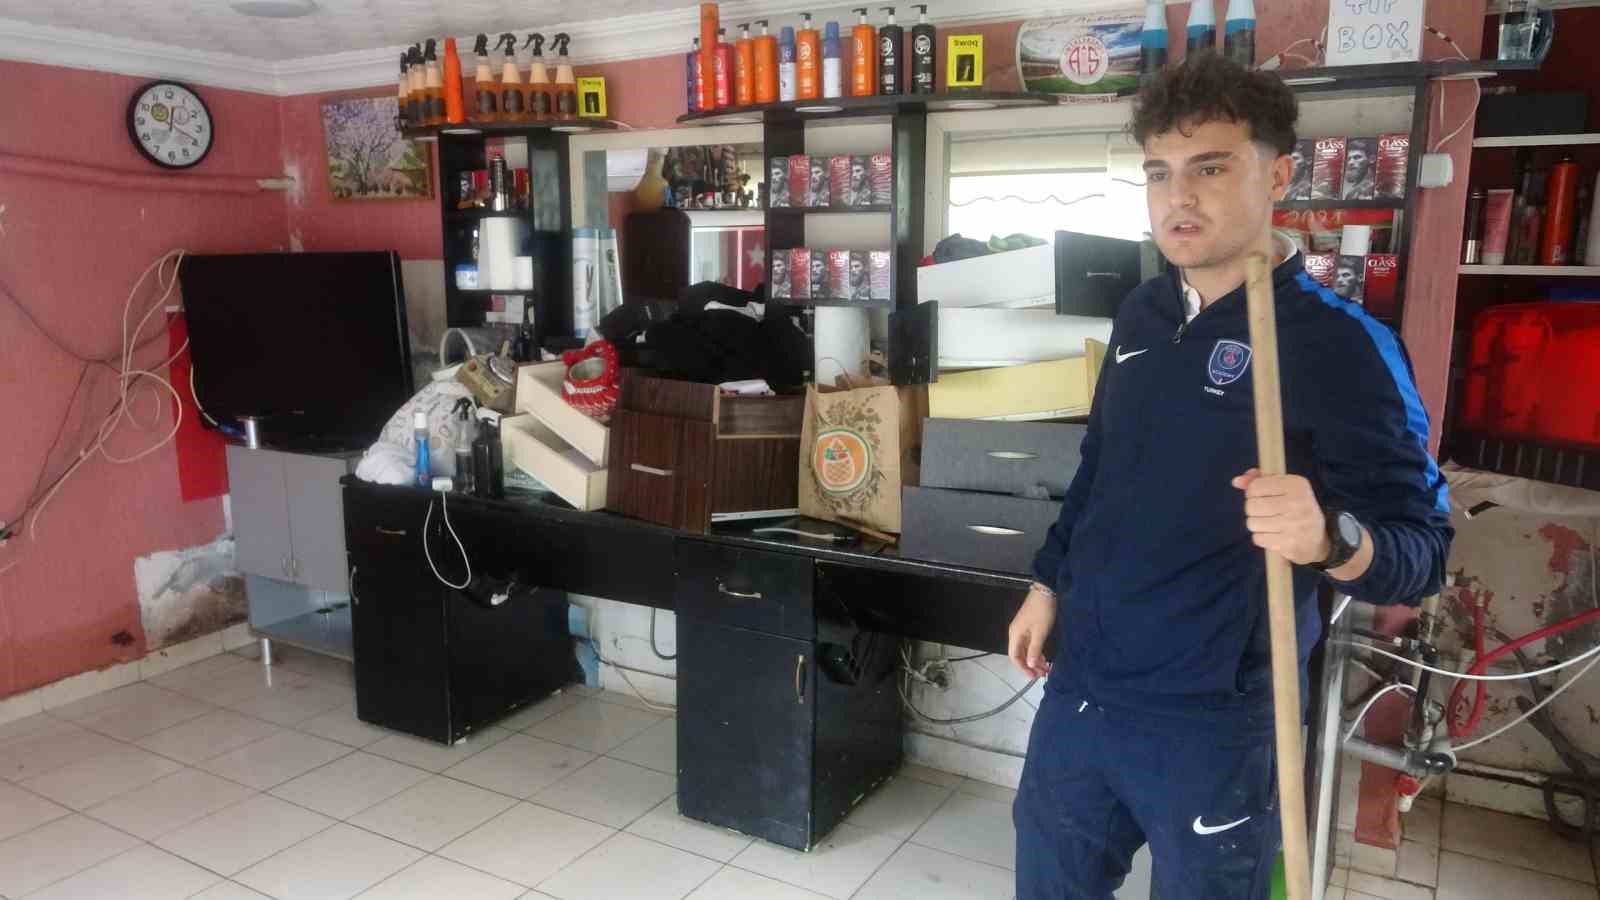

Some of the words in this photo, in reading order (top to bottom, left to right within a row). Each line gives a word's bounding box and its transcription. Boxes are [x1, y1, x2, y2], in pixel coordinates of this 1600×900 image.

[1337, 20, 1409, 54] BOX
[1315, 140, 1344, 150] CLASS
[1379, 138, 1409, 148] CLASS
[1367, 257, 1397, 268] CLASS
